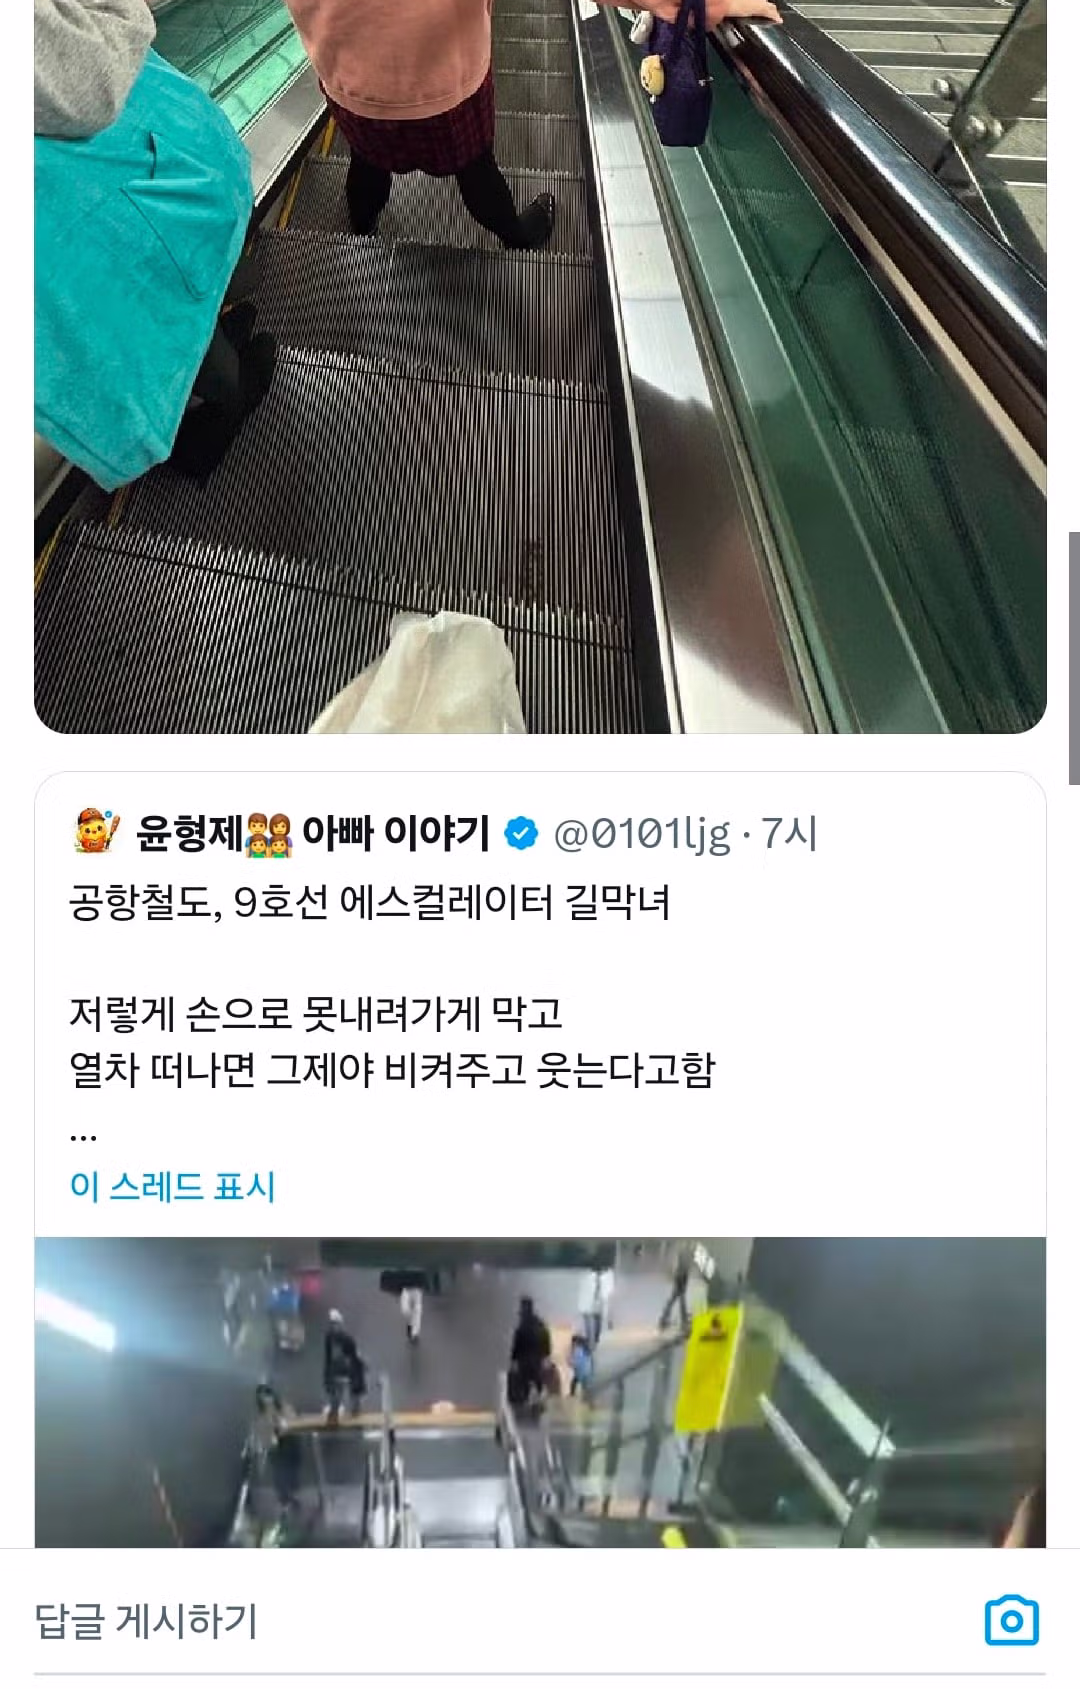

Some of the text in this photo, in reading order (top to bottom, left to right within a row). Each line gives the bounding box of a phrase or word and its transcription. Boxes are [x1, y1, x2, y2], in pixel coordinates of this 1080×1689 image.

[137, 814, 488, 853] 윤형제 아빠 이야기
[555, 816, 730, 856] @0101ljg
[762, 815, 815, 851] 7시
[69, 884, 668, 923] 공항철도, 9호선 에스컬레이터 길막녀
[70, 996, 562, 1033] 저렇게 손으로 못내려가게 막고
[71, 1052, 716, 1088] 열차 떠나면 그제야 비켜주고 웃는다고함
[72, 1171, 273, 1203] 이 스레드 표시
[36, 1604, 255, 1640] 답글 게시하기
